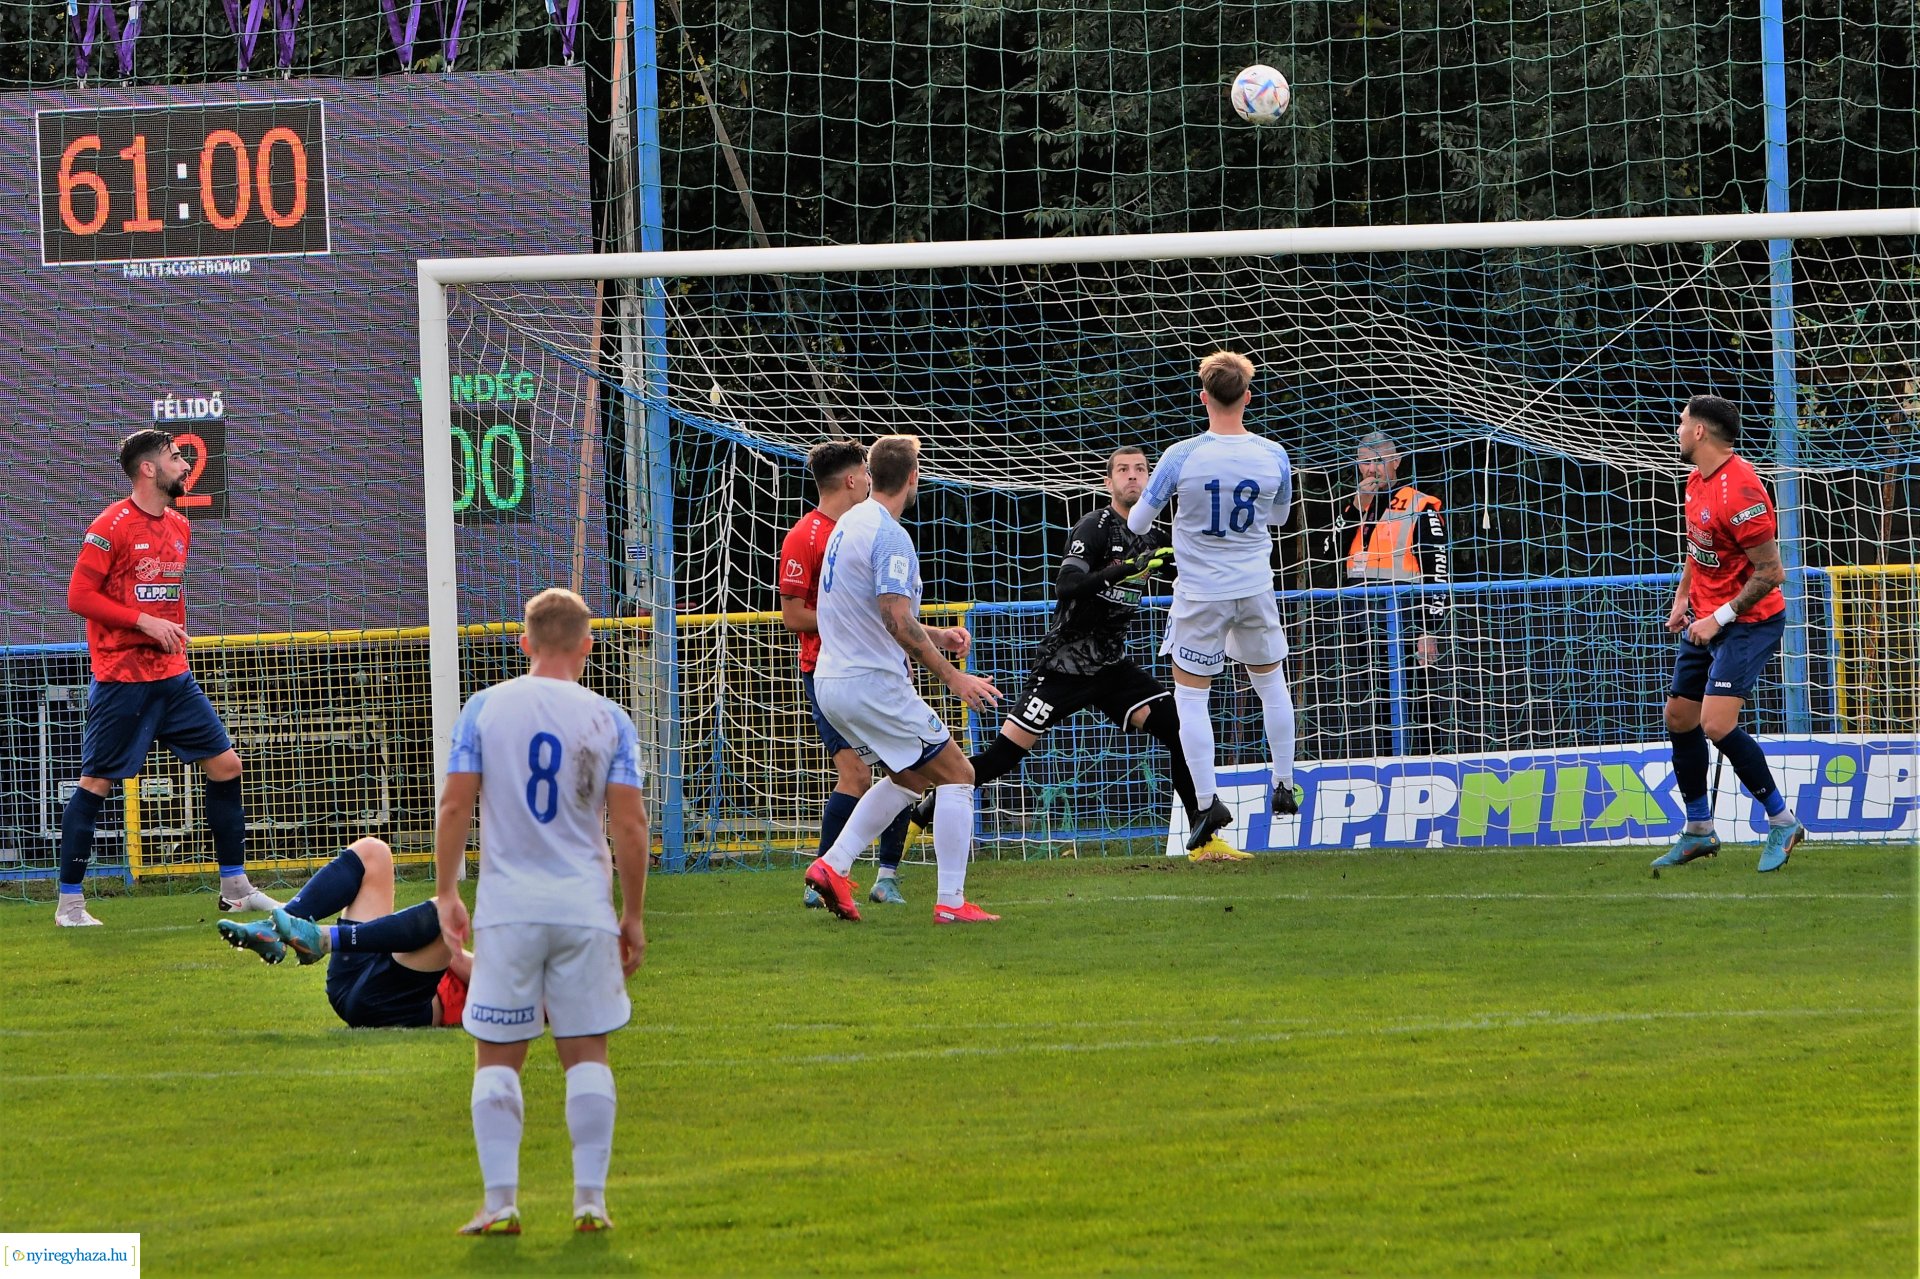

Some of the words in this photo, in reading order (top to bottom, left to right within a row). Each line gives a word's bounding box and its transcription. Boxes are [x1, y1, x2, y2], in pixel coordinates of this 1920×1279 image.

[57, 127, 308, 235] 61:00
[1202, 479, 1260, 537] 18
[1390, 497, 1408, 511] 21
[1715, 681, 1732, 689] JAKO
[1022, 696, 1054, 725] 95
[526, 731, 562, 824] 8
